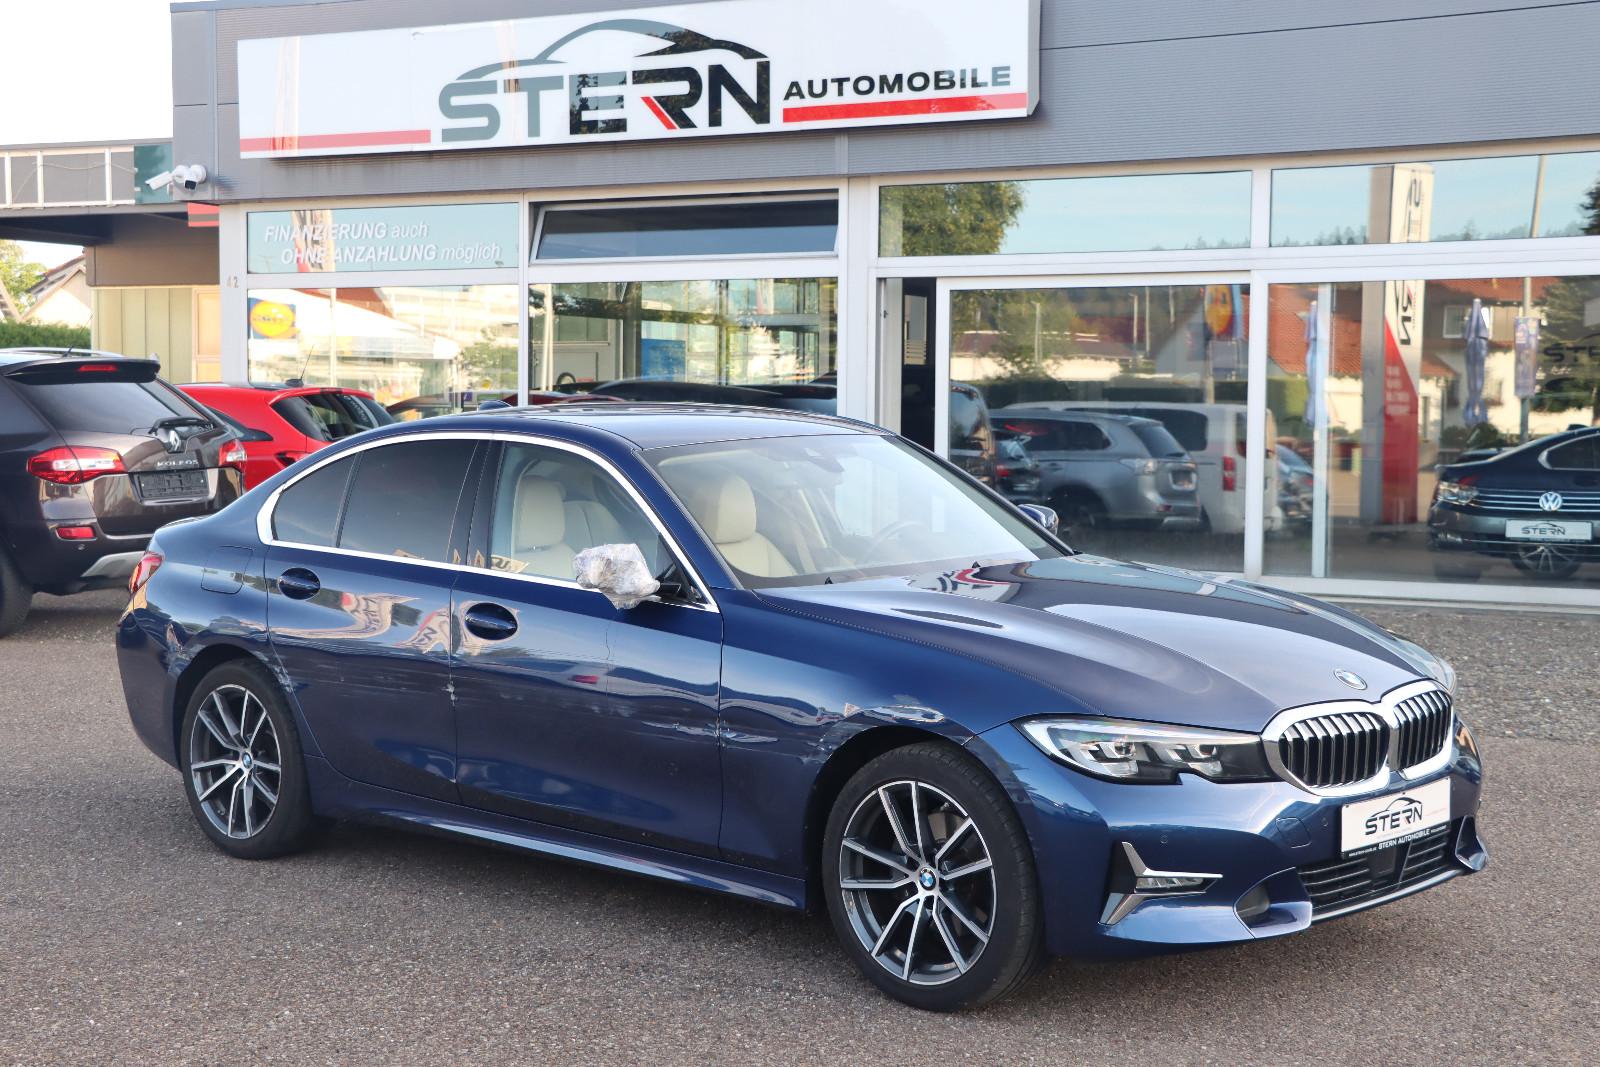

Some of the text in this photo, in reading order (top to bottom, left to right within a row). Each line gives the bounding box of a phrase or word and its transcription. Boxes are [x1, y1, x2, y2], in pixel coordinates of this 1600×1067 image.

[438, 60, 1011, 143] STERN AUTOMOBILE
[265, 220, 429, 242] FINANZIERUNG auch
[280, 242, 502, 265] OHNE ANZAHLUNG möglich
[1521, 527, 1566, 536] STERN
[1365, 803, 1423, 836] STERN
[1378, 838, 1397, 850] STERN
[1397, 828, 1430, 844] AUTOMOBILE
